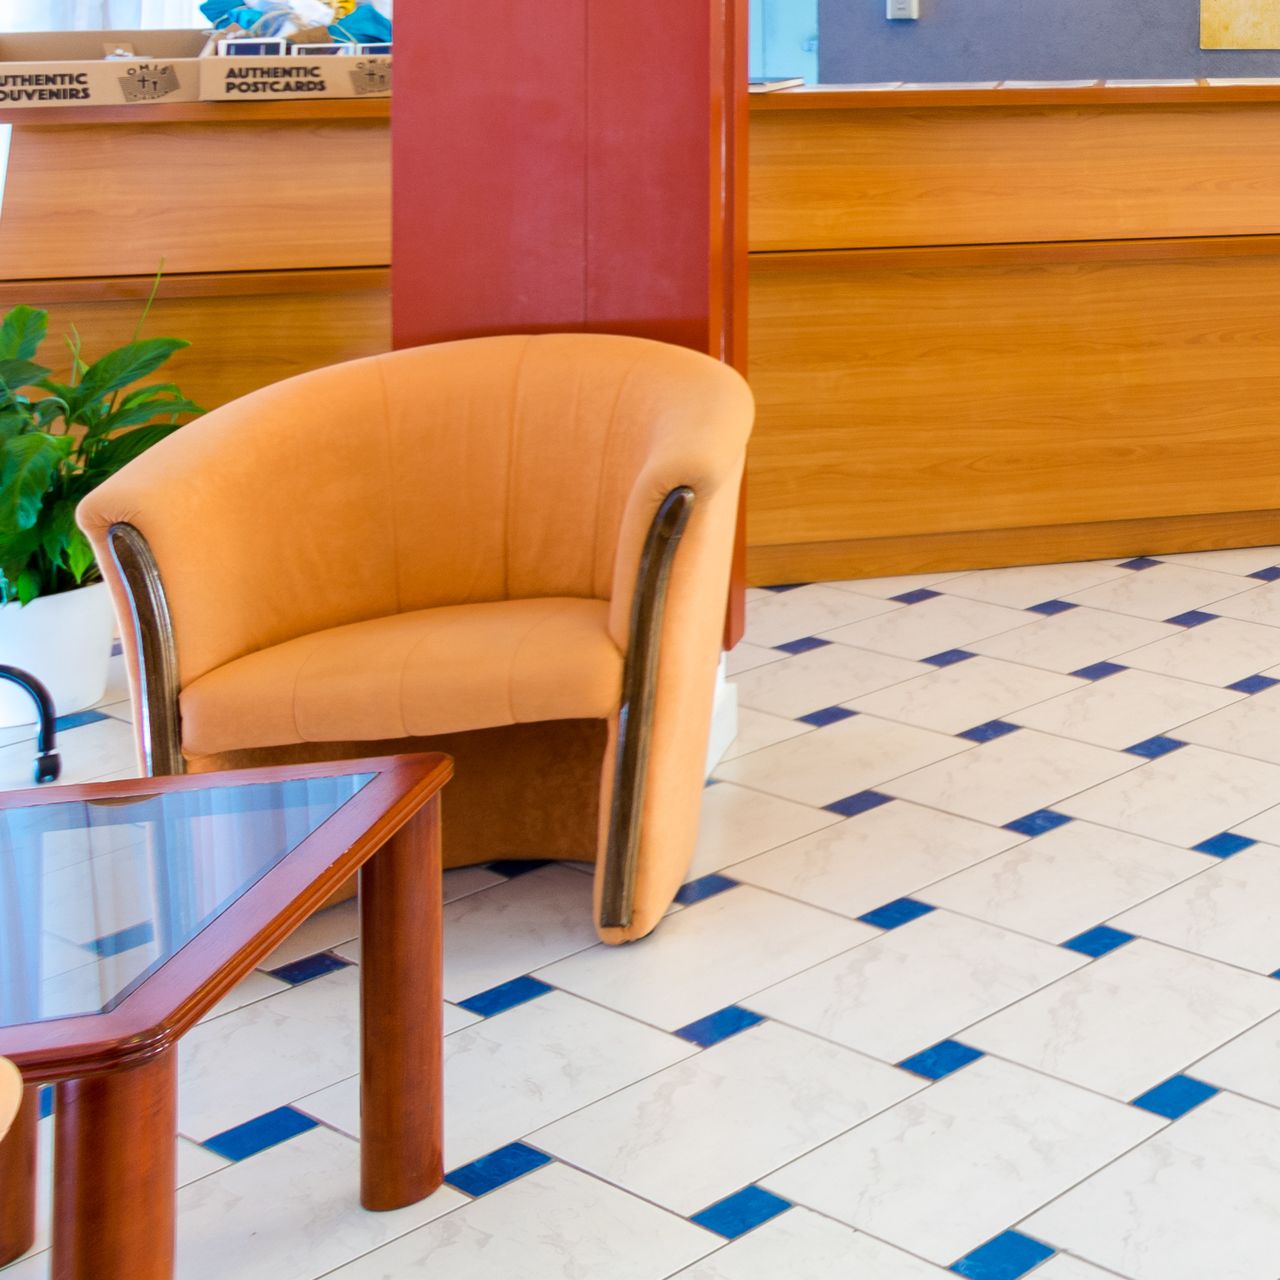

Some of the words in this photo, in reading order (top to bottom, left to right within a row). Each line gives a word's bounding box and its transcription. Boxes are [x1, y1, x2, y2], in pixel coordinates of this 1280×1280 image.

[225, 66, 321, 79] AUTHENTIC
[0, 73, 88, 87] UTHENTIC
[225, 80, 327, 94] POSTCARDS
[0, 87, 91, 102] OUVENIRS
